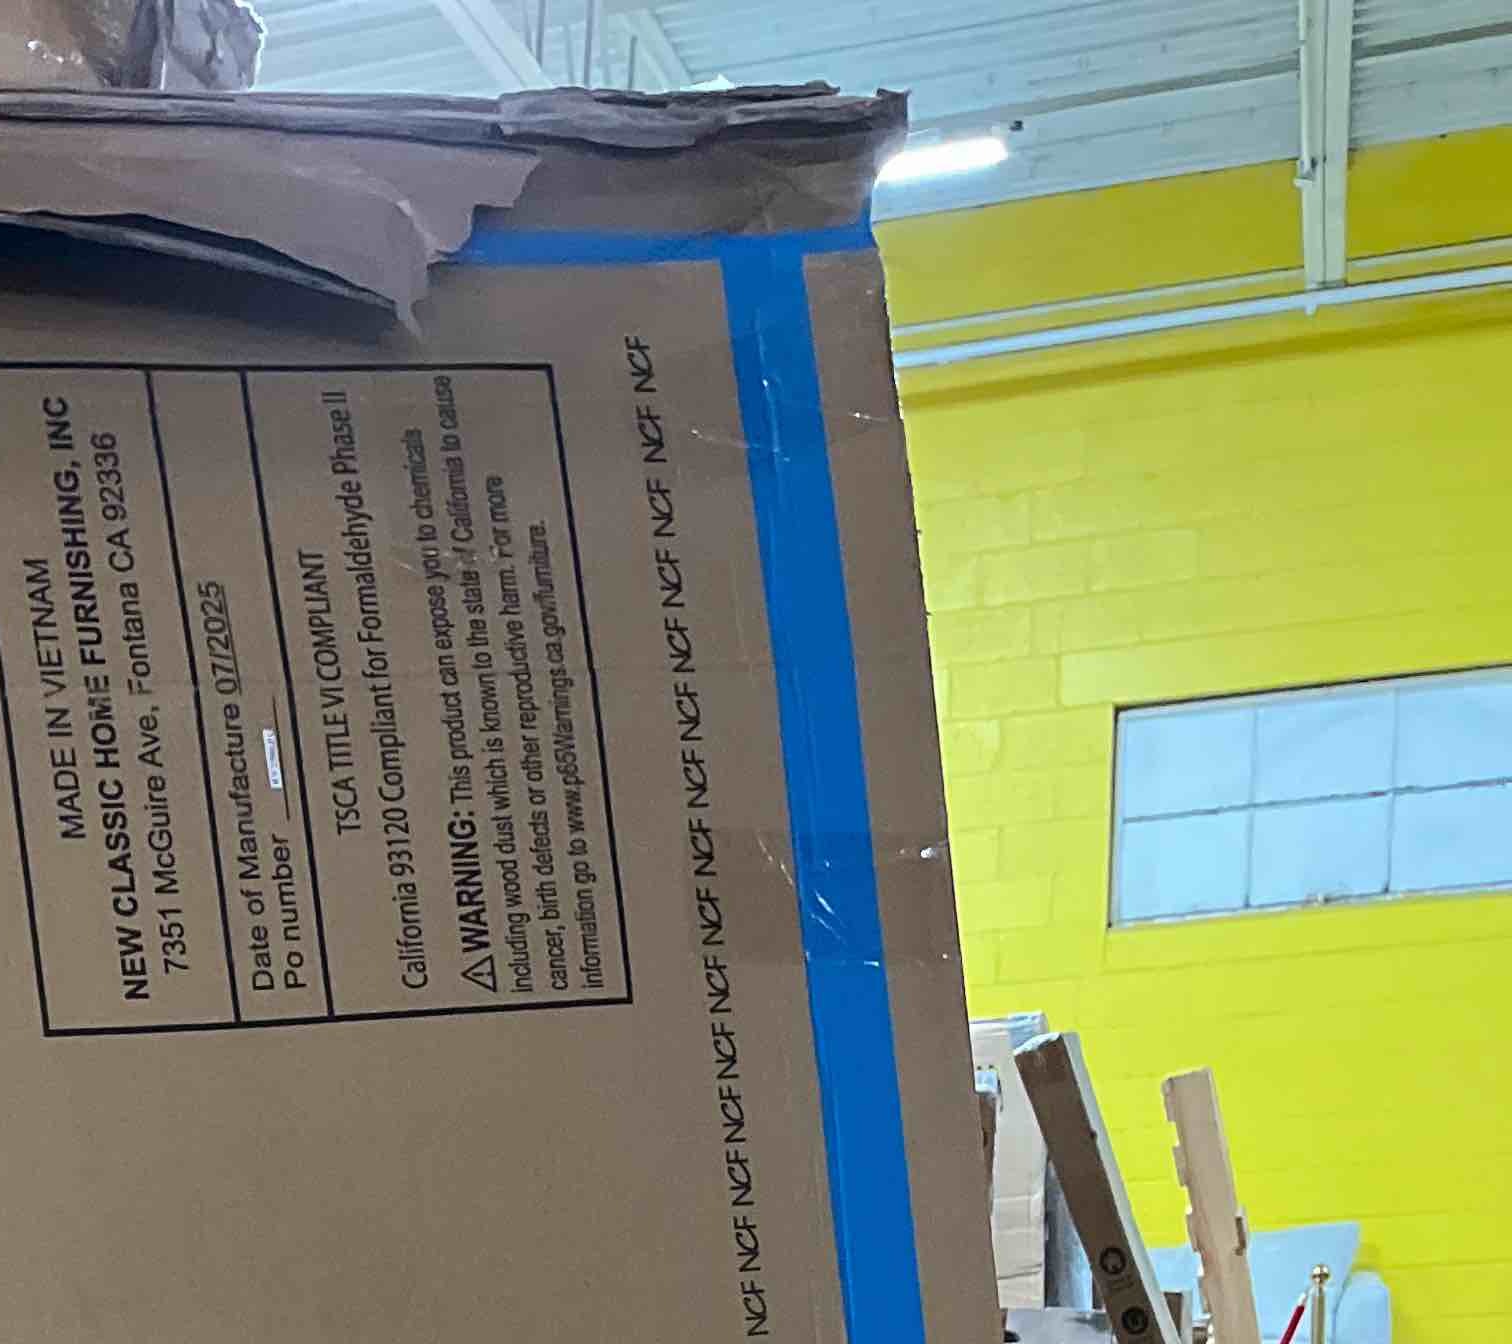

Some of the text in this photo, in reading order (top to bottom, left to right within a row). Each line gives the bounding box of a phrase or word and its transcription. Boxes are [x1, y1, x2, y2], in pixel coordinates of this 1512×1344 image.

[625, 336, 656, 392] NCF
[434, 376, 458, 430] cause
[440, 435, 461, 451] to
[636, 406, 667, 463] NCF
[443, 456, 474, 542] California
[486, 476, 509, 523] more
[646, 478, 676, 537] NCF
[459, 569, 484, 614] state
[498, 565, 520, 615] harm.
[656, 549, 685, 607] NCF
[466, 619, 489, 647] the
[472, 652, 492, 669] to
[664, 617, 695, 672] NCF
[23, 559, 86, 839] MADE IN VIETNAM
[43, 397, 150, 1000] NEW CLASSIC HOME FURNISHING, INC
[91, 432, 190, 974] 7351 McGuire Ave, Fontana CA 92336
[298, 549, 361, 836] TSCA TITLE VI COMPLIANT
[322, 392, 428, 989] California 93120 Compliant for Formaldehyde Phase II
[401, 428, 491, 953] WARNING: This product can expose you to chemicals
[478, 672, 501, 732] known
[504, 620, 540, 729] reproductive
[674, 682, 703, 741] NCF
[481, 737, 504, 753] is
[520, 735, 543, 782] other
[198, 582, 274, 991] Date of Manufacture 07/2025
[484, 758, 511, 811] which
[528, 786, 546, 805] or
[682, 749, 709, 808] NCF
[490, 815, 516, 854] dust
[528, 810, 554, 876] defects
[567, 838, 588, 856] to
[689, 819, 717, 876] NCF
[496, 859, 523, 908] wood
[535, 881, 560, 920] birth
[573, 861, 597, 884] go
[272, 833, 307, 989] Po number
[574, 888, 604, 988] information
[696, 888, 724, 945] NCF
[504, 913, 533, 992] including
[545, 925, 568, 990] cancer,
[703, 955, 732, 1014] NCF
[711, 1022, 739, 1079] NCF
[719, 1085, 746, 1143] NCF
[726, 1150, 754, 1206] NCF
[733, 1216, 761, 1272] NCF
[740, 1280, 768, 1336] NCF
